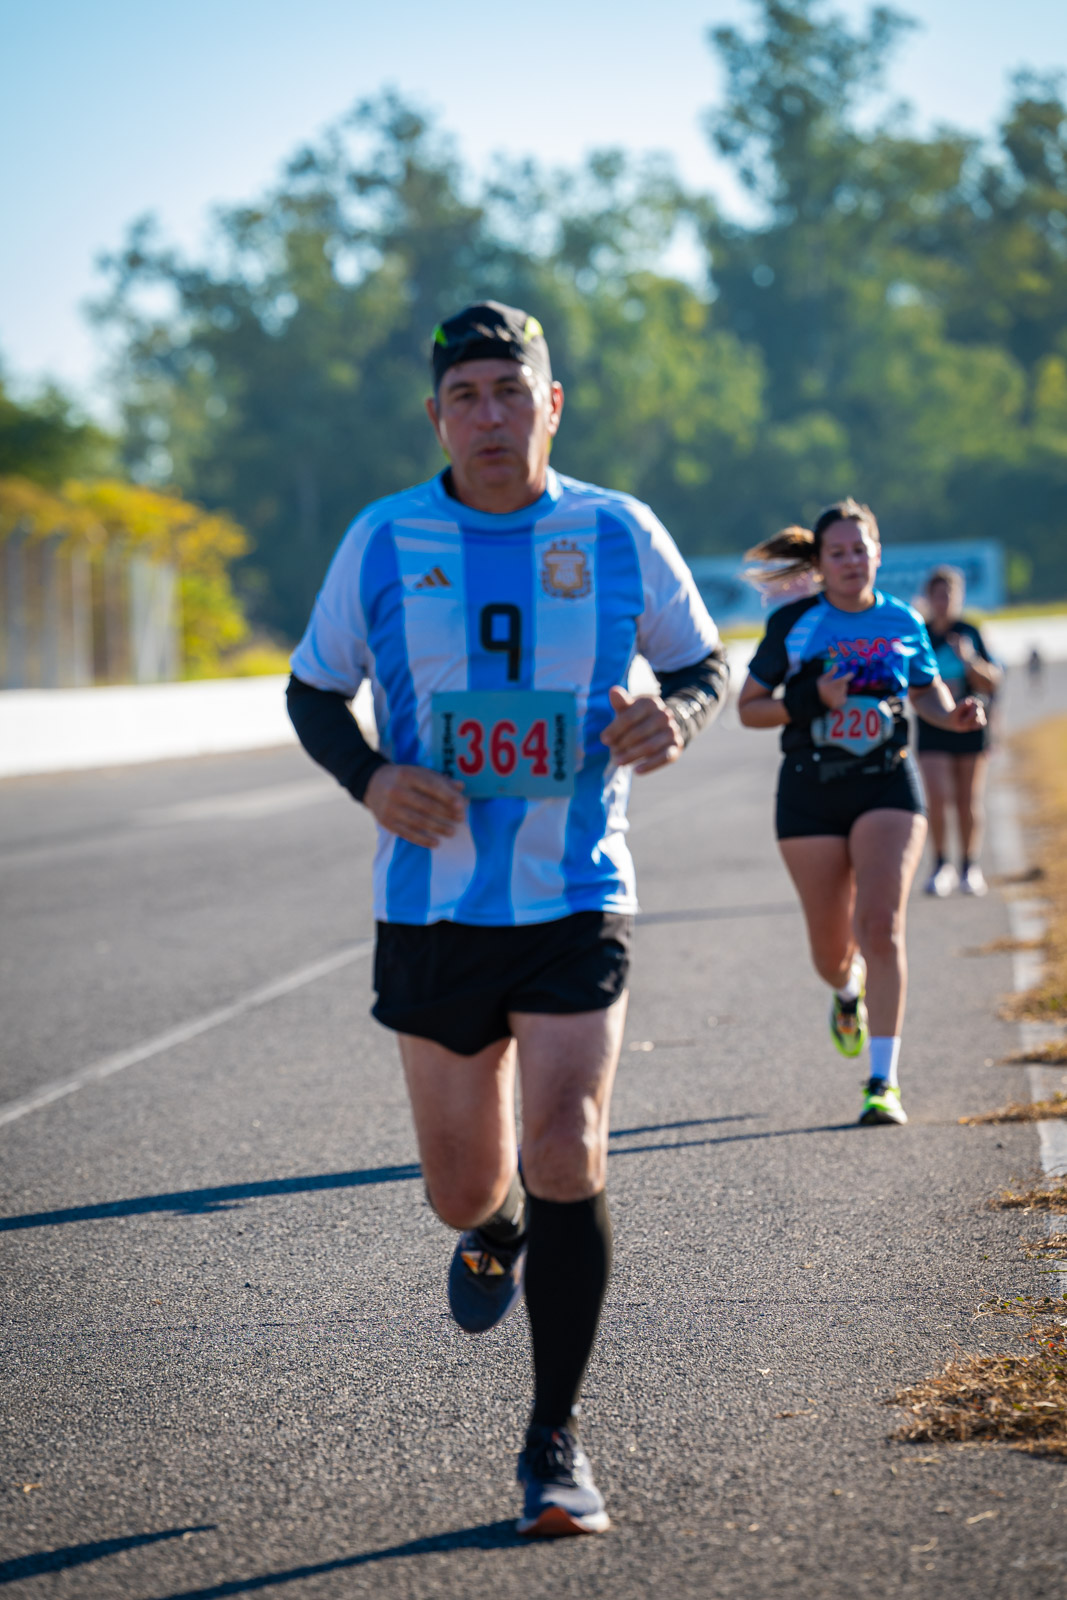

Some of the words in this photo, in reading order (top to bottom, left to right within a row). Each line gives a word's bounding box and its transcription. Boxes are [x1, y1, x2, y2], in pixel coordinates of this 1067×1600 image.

[480, 603, 521, 682] 9
[457, 719, 549, 776] 364
[831, 708, 880, 739] 220
